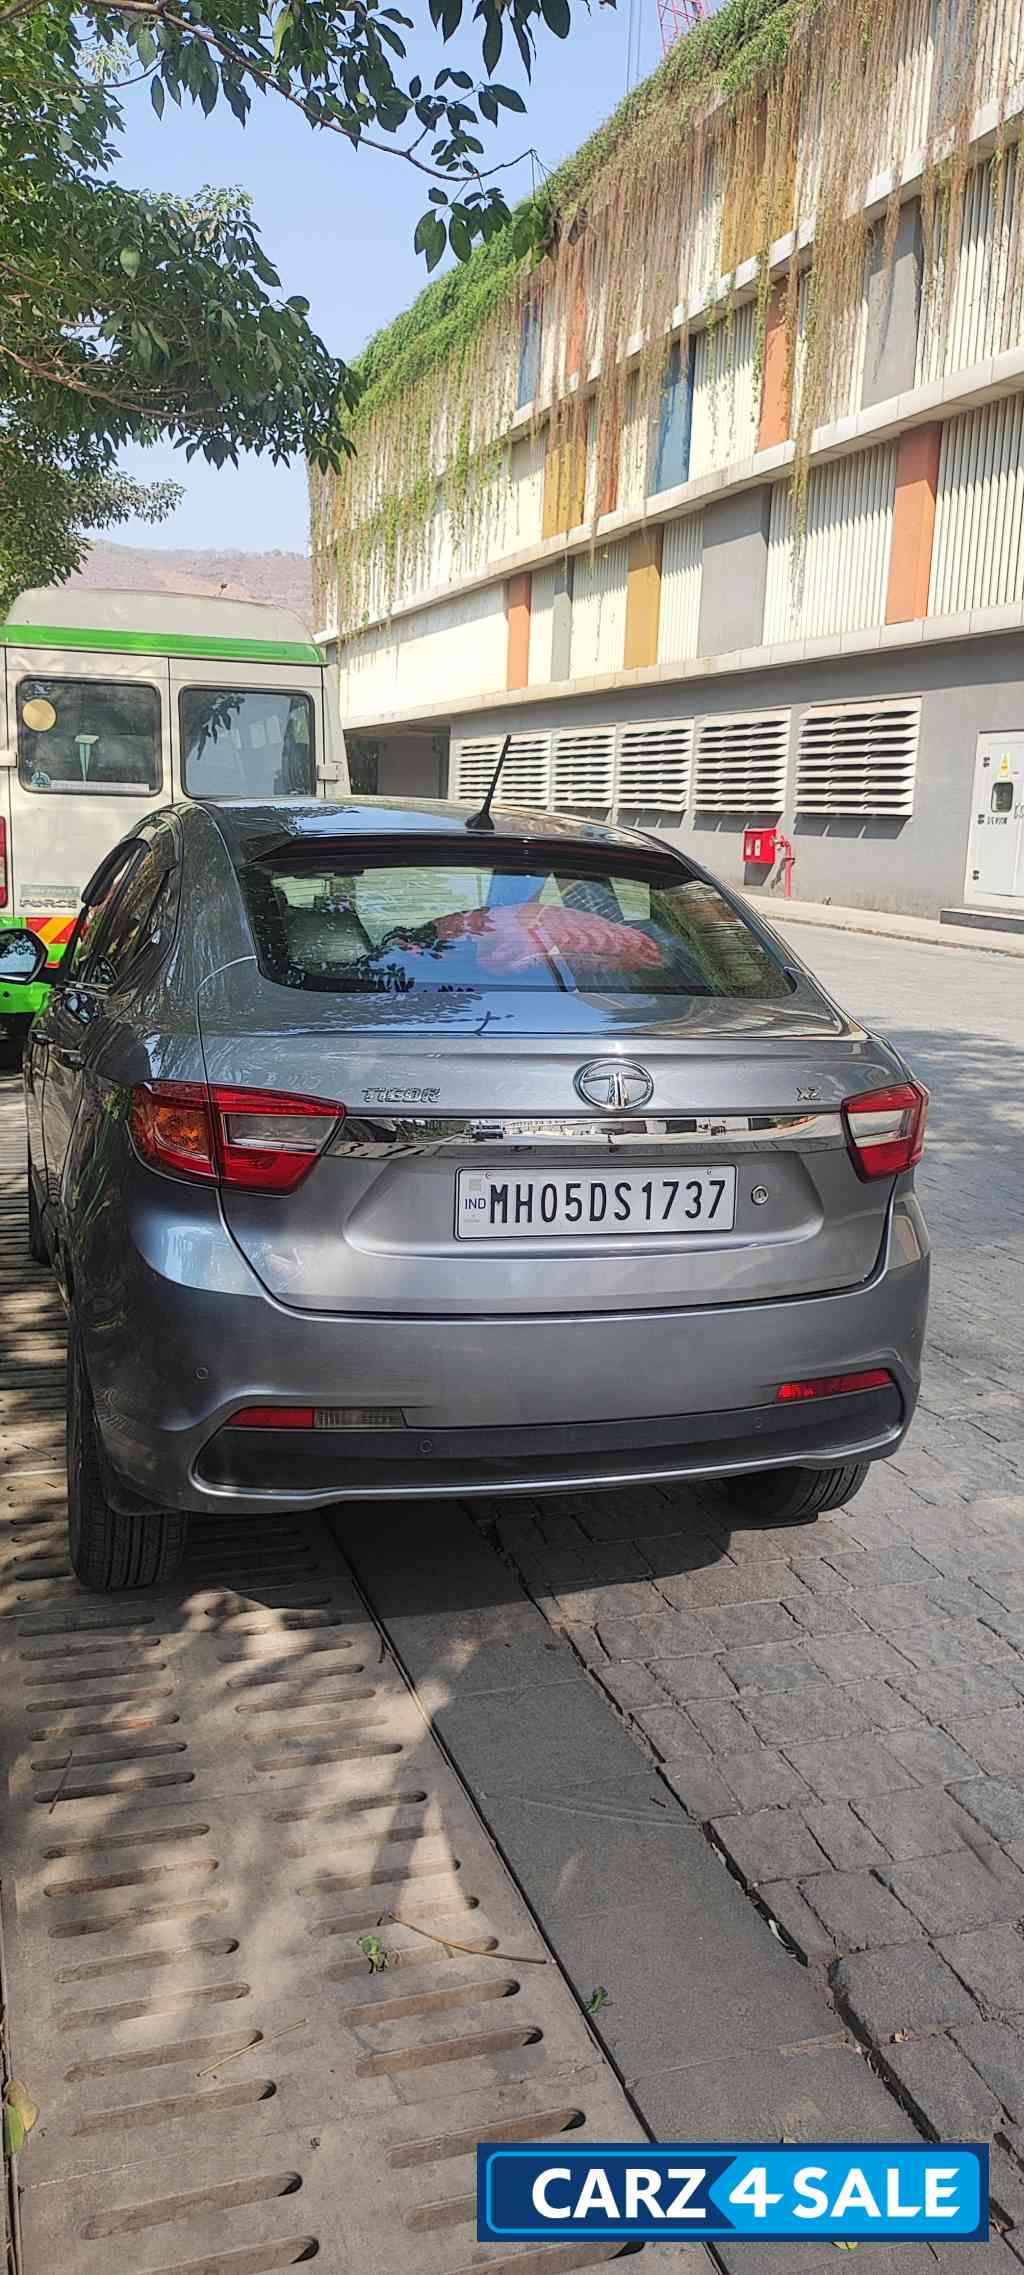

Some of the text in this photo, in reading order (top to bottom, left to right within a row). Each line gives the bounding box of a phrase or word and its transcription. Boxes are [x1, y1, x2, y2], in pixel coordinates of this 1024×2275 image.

[361, 1087, 441, 1103] TIGOR
[464, 1198, 486, 1210] IND
[489, 1179, 726, 1224] MH05DS1737
